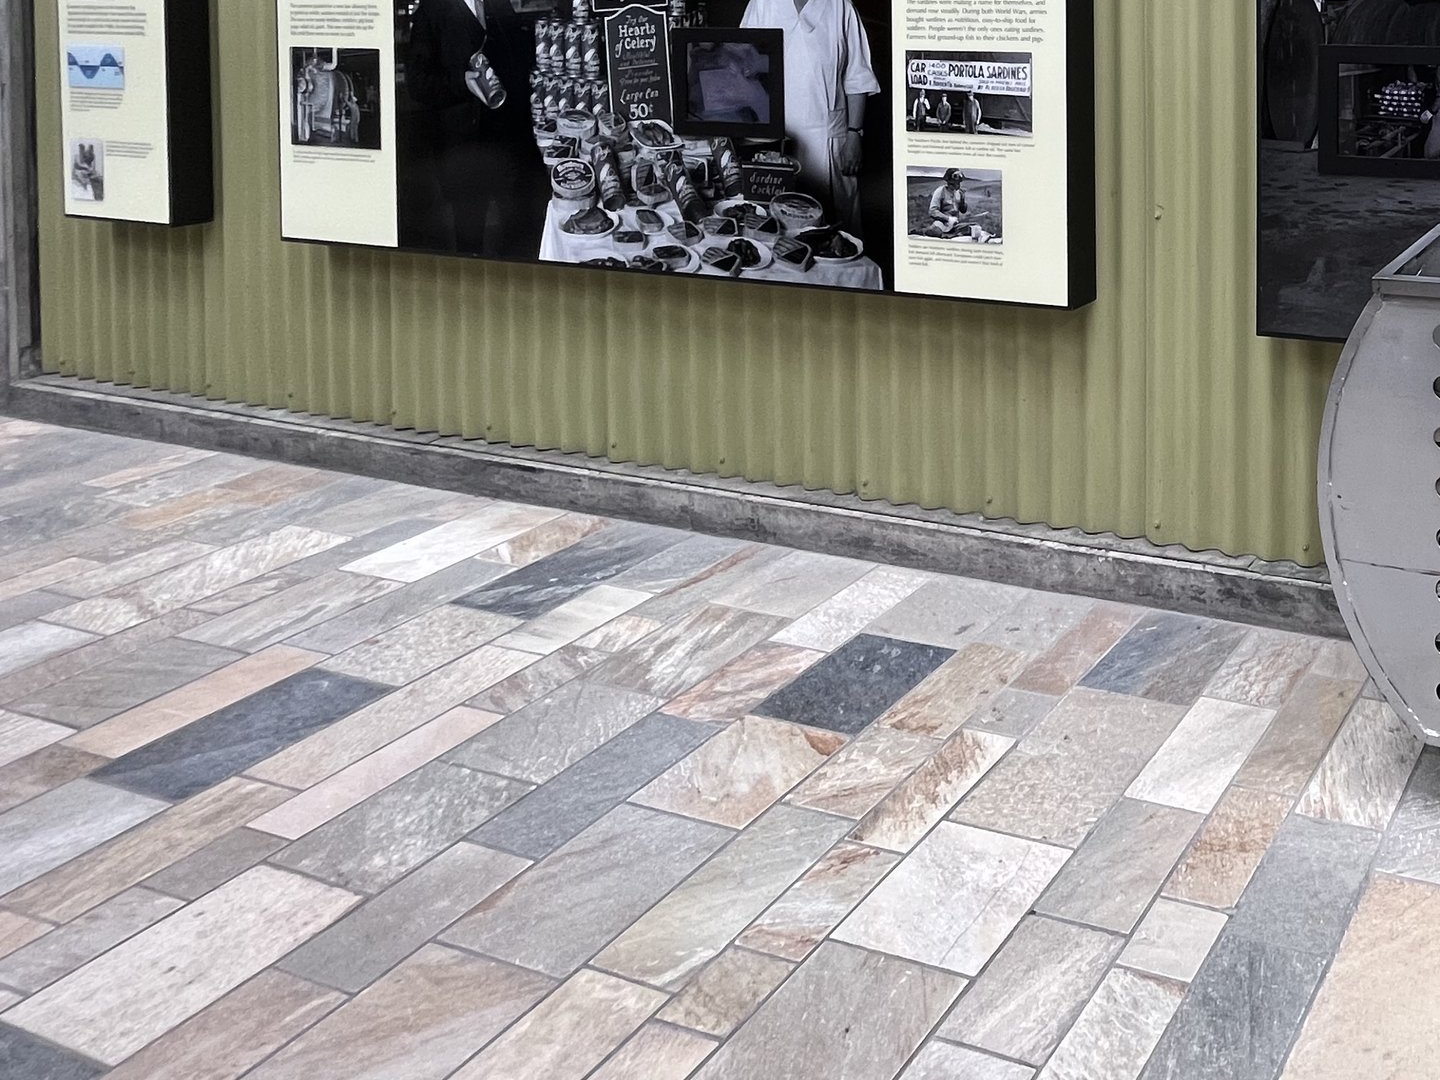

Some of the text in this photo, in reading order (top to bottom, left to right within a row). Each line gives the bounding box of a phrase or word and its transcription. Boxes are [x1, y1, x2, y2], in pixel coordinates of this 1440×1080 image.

[619, 23, 655, 37] Hearts
[625, 36, 656, 52] Celery
[911, 63, 1027, 80] CAR PORTOLA SARDINES
[911, 75, 927, 86] LOAD
